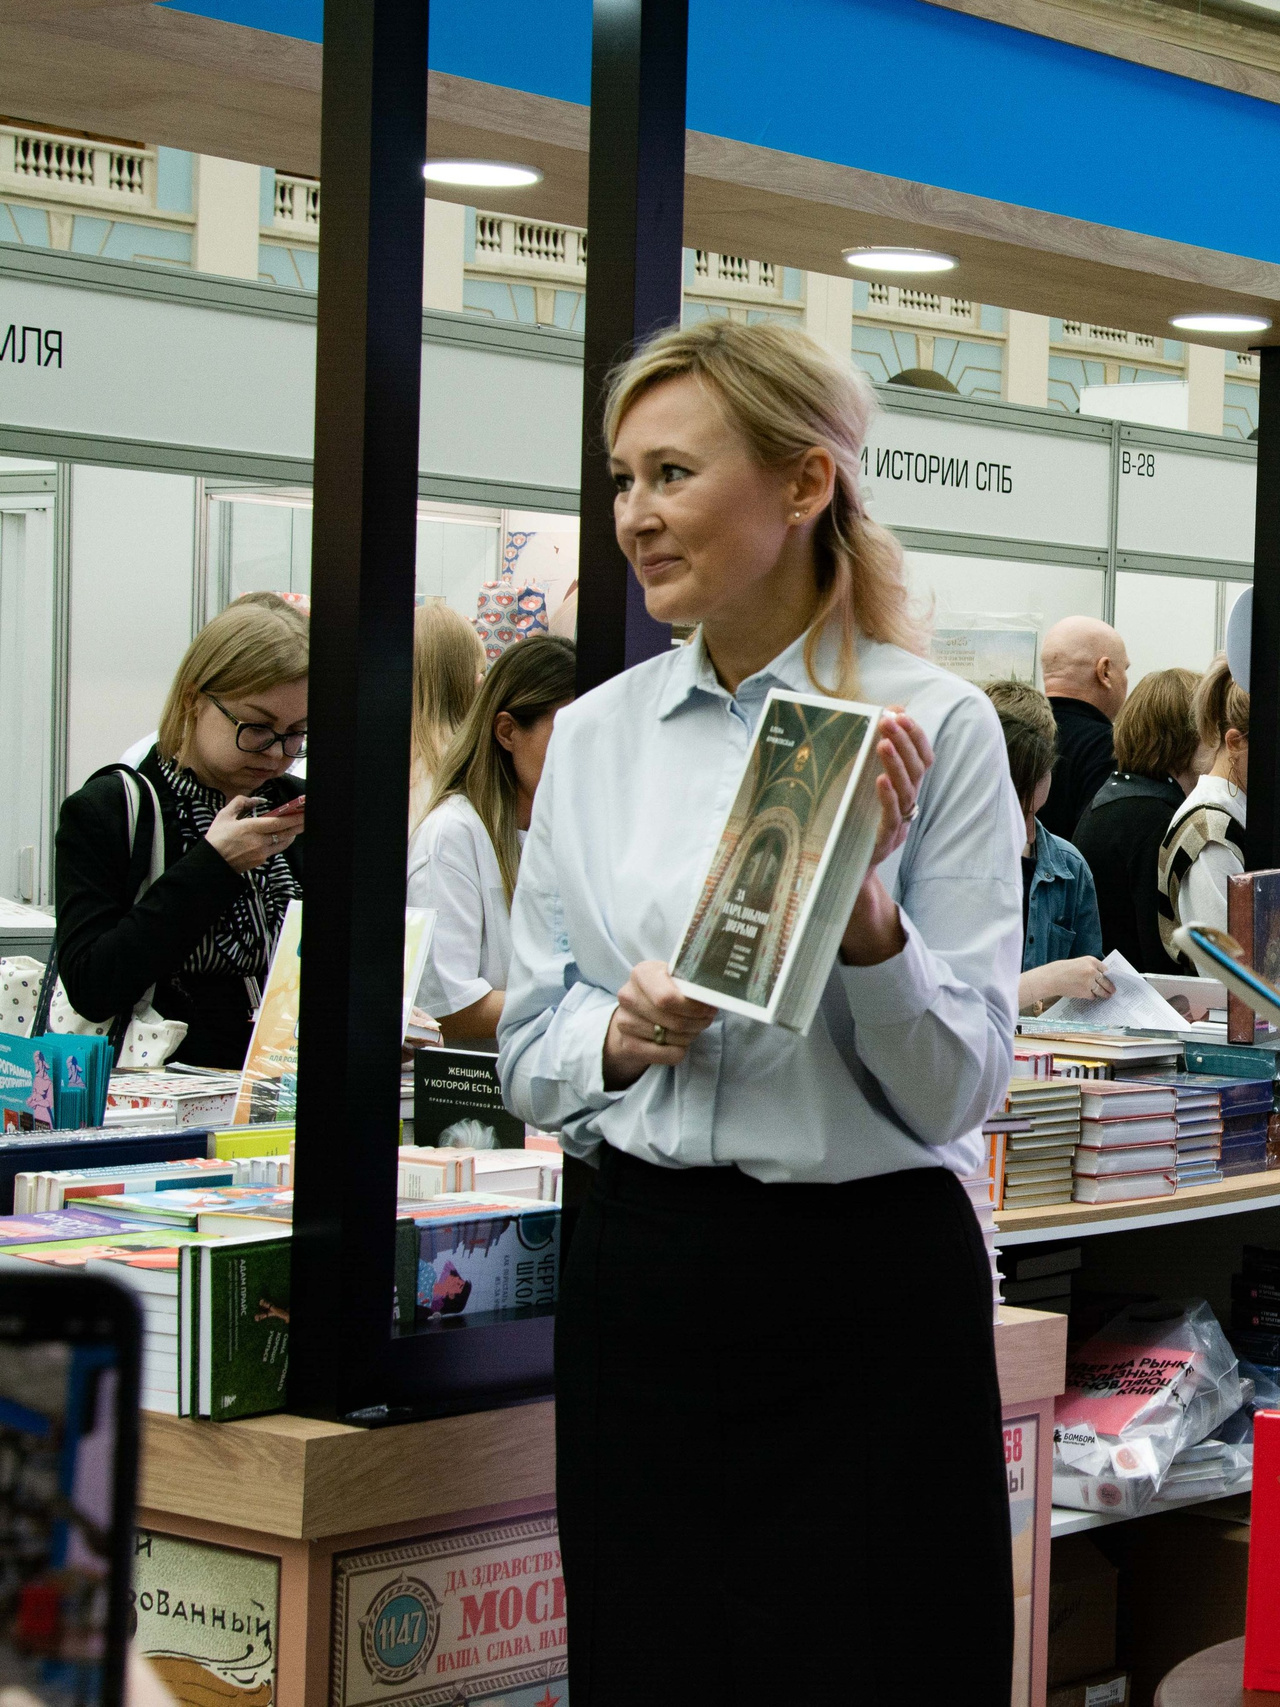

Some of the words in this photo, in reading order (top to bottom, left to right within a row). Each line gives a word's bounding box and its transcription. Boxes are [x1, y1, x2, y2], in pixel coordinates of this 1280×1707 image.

[877, 448, 968, 488] ИСТОРИИ
[976, 461, 1012, 493] СПБ
[448, 1066, 493, 1081] ЖЕНЩИНА,
[424, 1078, 430, 1086] У
[431, 1079, 470, 1091] КОТОРОЙ
[472, 1084, 492, 1094] ЕСТЬ
[429, 1096, 453, 1105] ПРАВИЛА
[455, 1099, 491, 1109] СЧАСТЛИВОЙ
[1112, 1361, 1136, 1371] НА
[1063, 1432, 1095, 1444] БОМБОРА
[444, 1569, 467, 1596] ДА
[378, 1611, 424, 1651] 1147
[436, 1646, 481, 1674] НАША
